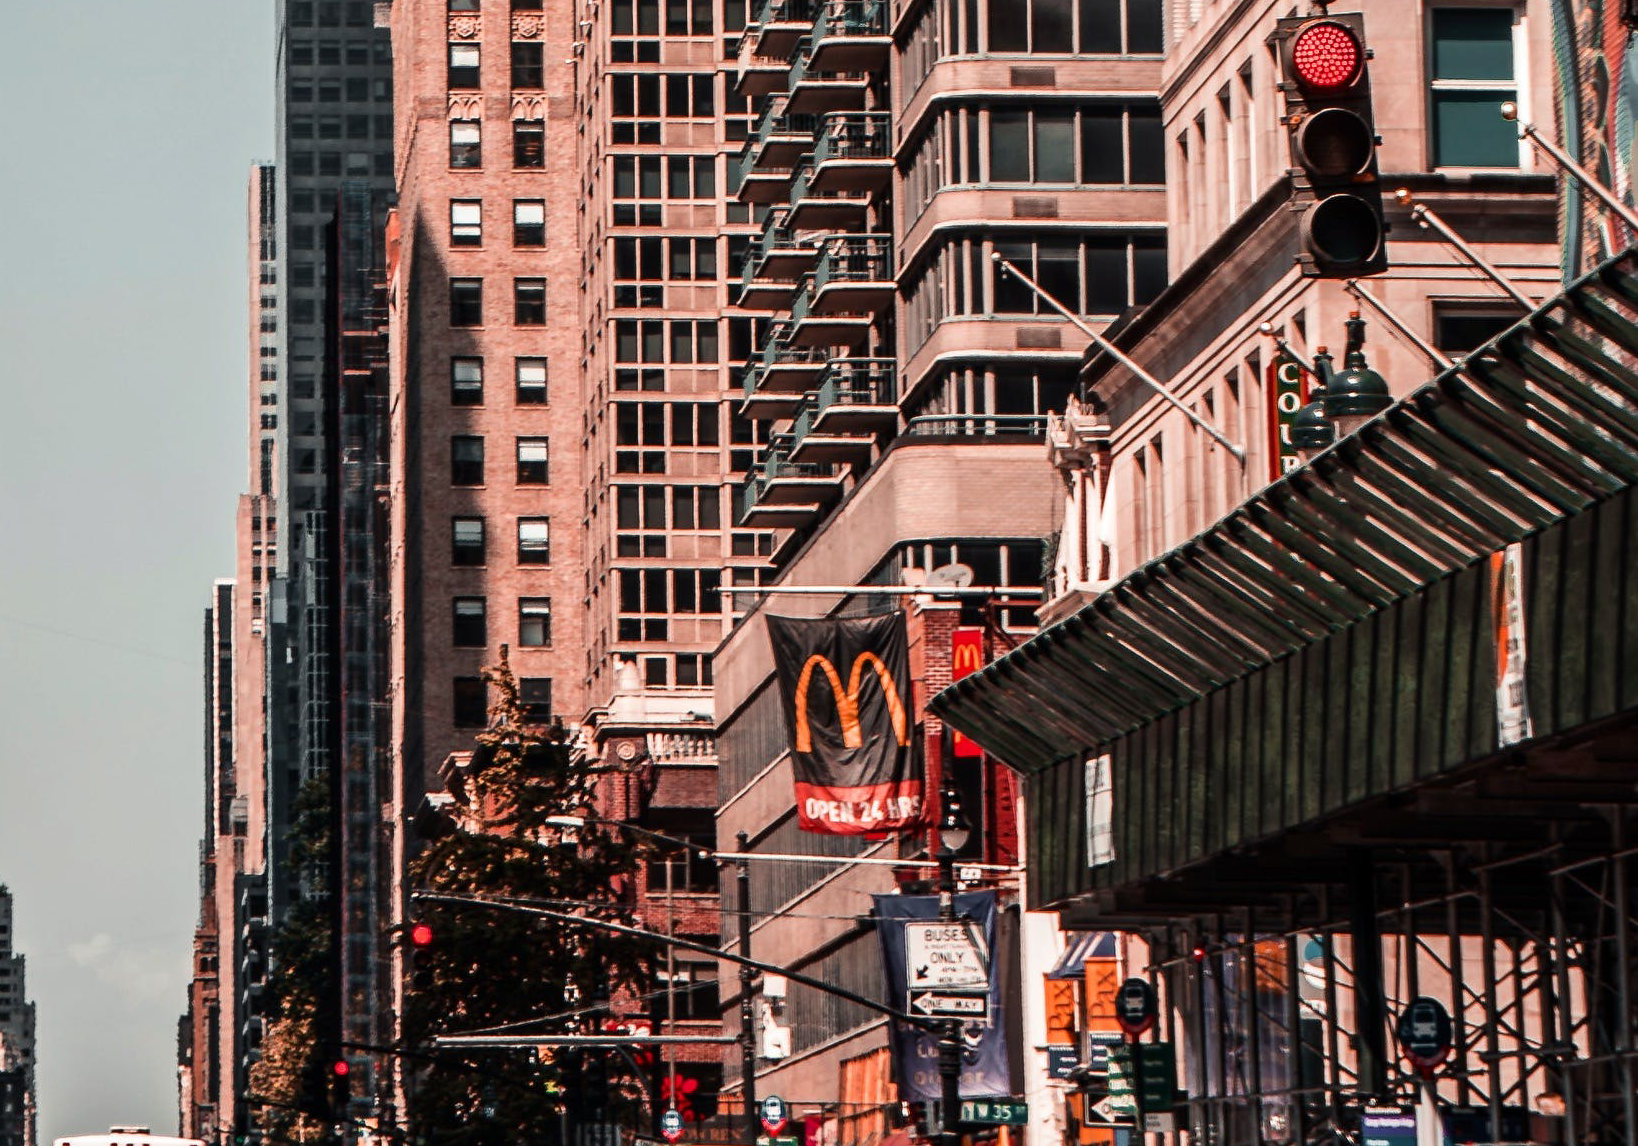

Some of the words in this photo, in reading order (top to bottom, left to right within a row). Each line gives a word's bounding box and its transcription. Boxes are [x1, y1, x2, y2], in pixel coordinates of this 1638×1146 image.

[805, 797, 855, 823] OPEN
[859, 799, 883, 822] 24
[886, 795, 922, 819] HRS
[924, 929, 968, 942] BUSES
[930, 951, 964, 964] ONLY
[1090, 970, 1116, 1018] Pax
[921, 998, 942, 1009] ONE
[955, 1000, 977, 1009] WAY
[1049, 984, 1074, 1031] Pax
[992, 1104, 1013, 1121] 35
